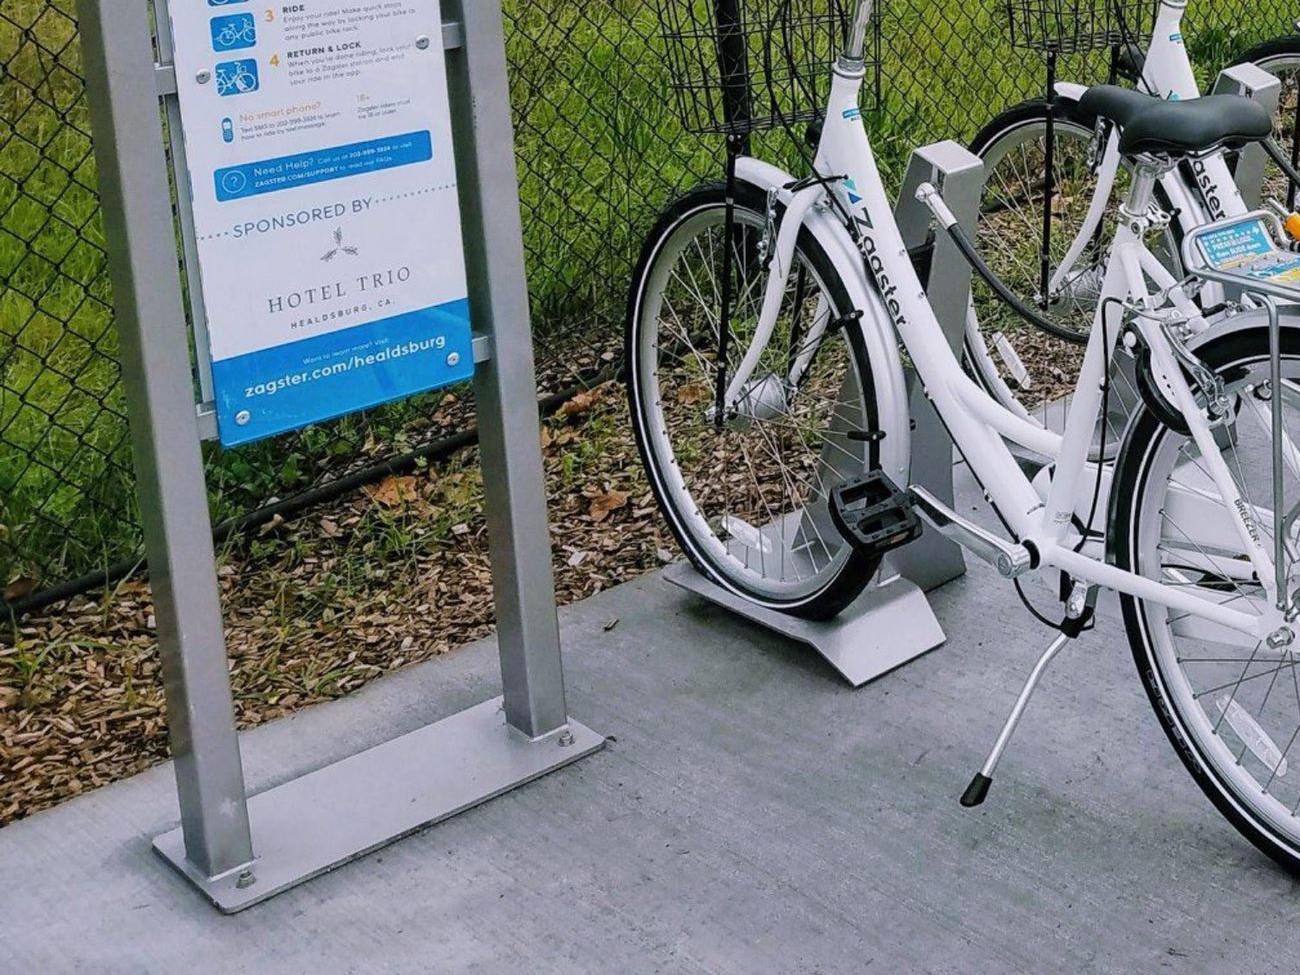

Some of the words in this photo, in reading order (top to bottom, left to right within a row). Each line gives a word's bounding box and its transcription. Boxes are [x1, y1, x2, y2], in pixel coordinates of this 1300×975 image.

[264, 9, 274, 23] 3
[282, 4, 305, 14] RIDE
[286, 46, 325, 59] RETURN
[327, 45, 334, 53] &
[336, 40, 362, 52] LOCK
[269, 54, 280, 67] 4
[239, 113, 255, 123] No
[256, 107, 285, 120] smart
[286, 100, 321, 116] phone?
[253, 163, 283, 177] Need
[284, 158, 315, 174] Help?
[233, 203, 346, 239] SPONSORED
[351, 197, 373, 214] BY
[267, 282, 346, 314] HOTEL
[356, 266, 411, 292] TRIO
[290, 303, 373, 330] HEALDSBURG,
[244, 335, 446, 399] zagster.com/healdsburg
